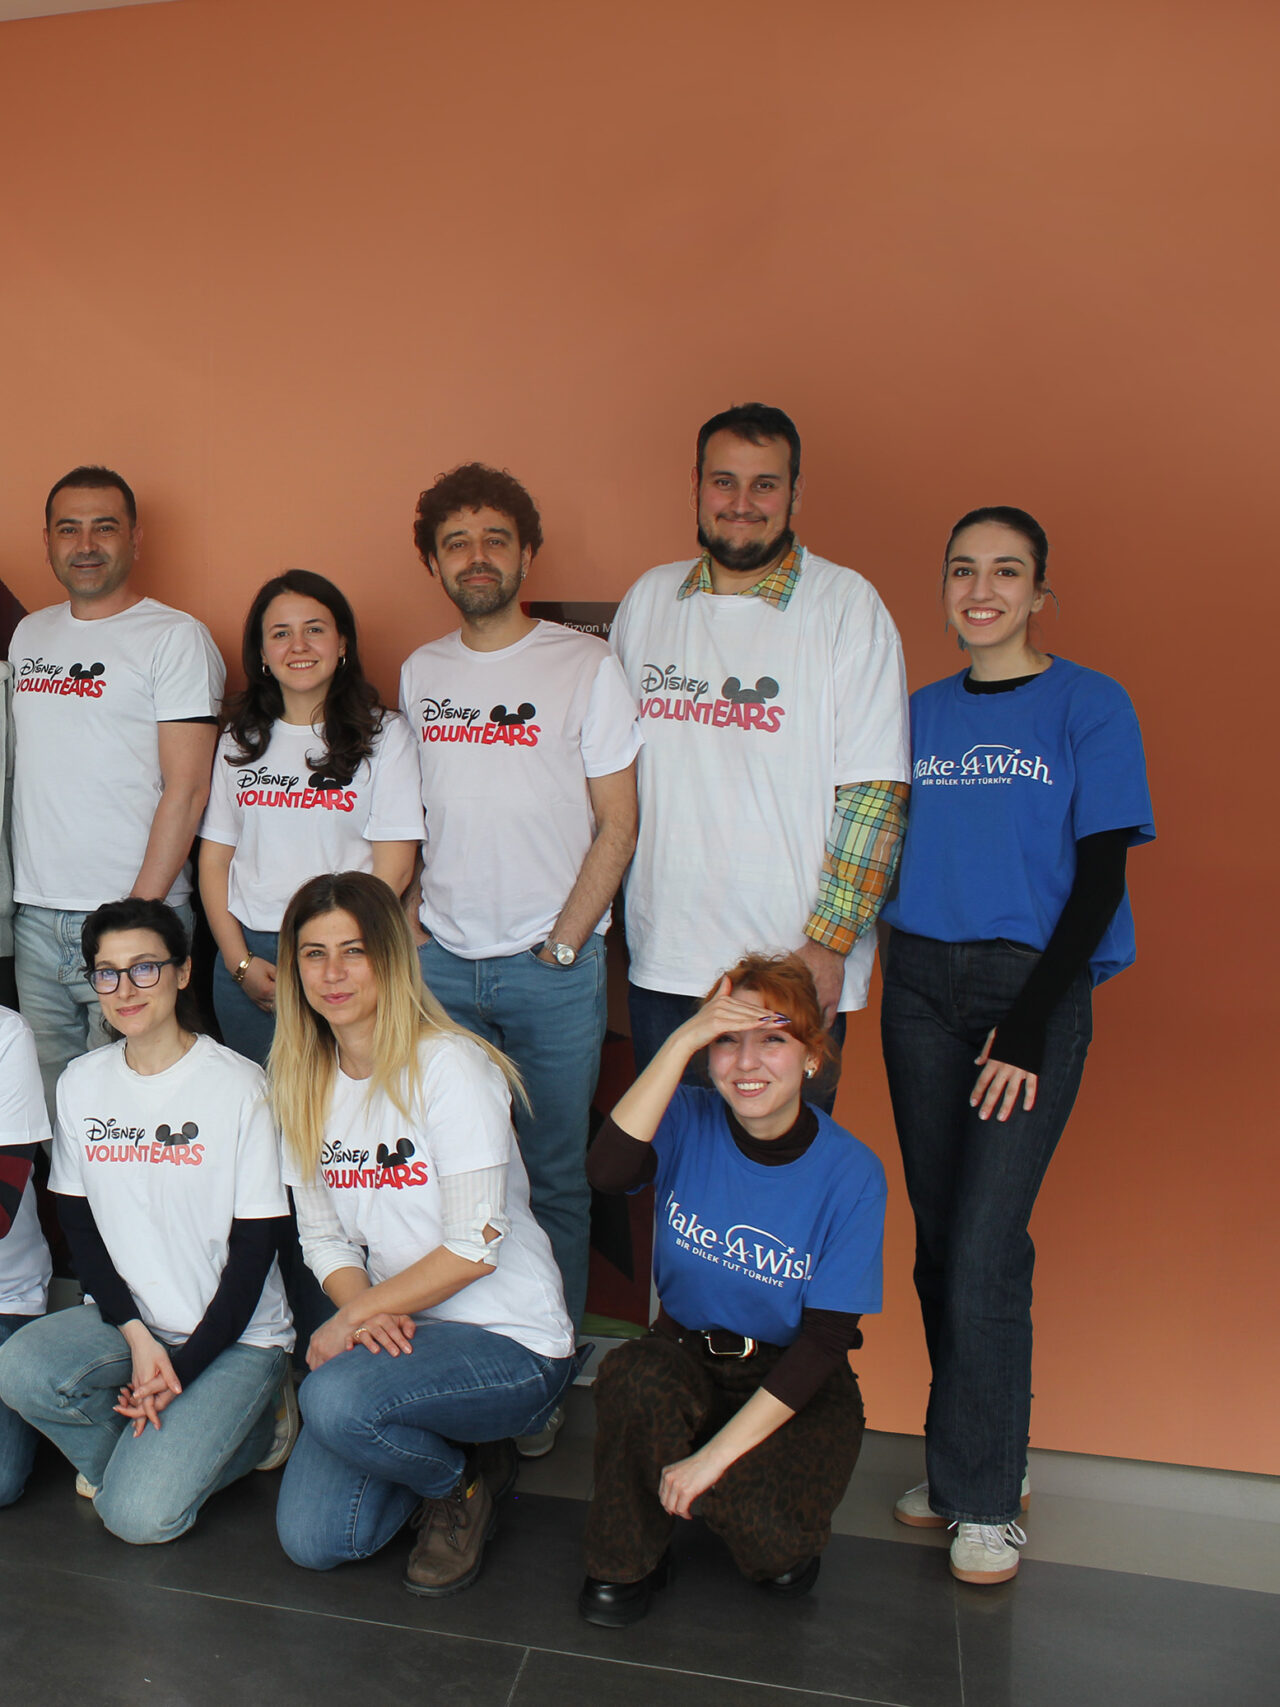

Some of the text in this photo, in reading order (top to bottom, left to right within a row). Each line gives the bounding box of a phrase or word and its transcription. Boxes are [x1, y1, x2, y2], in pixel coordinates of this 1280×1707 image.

[20, 657, 64, 680] Disney
[420, 698, 480, 727] Disney
[639, 697, 786, 733] VOLUNTEARS
[421, 722, 541, 747] VOLUNTEARS
[236, 766, 299, 794] Disney
[236, 788, 358, 812] VOLUNTEARS
[83, 1117, 146, 1148] Disney
[84, 1141, 205, 1166] VOLUNTEARS
[324, 1161, 428, 1190] OLUNTEARS
